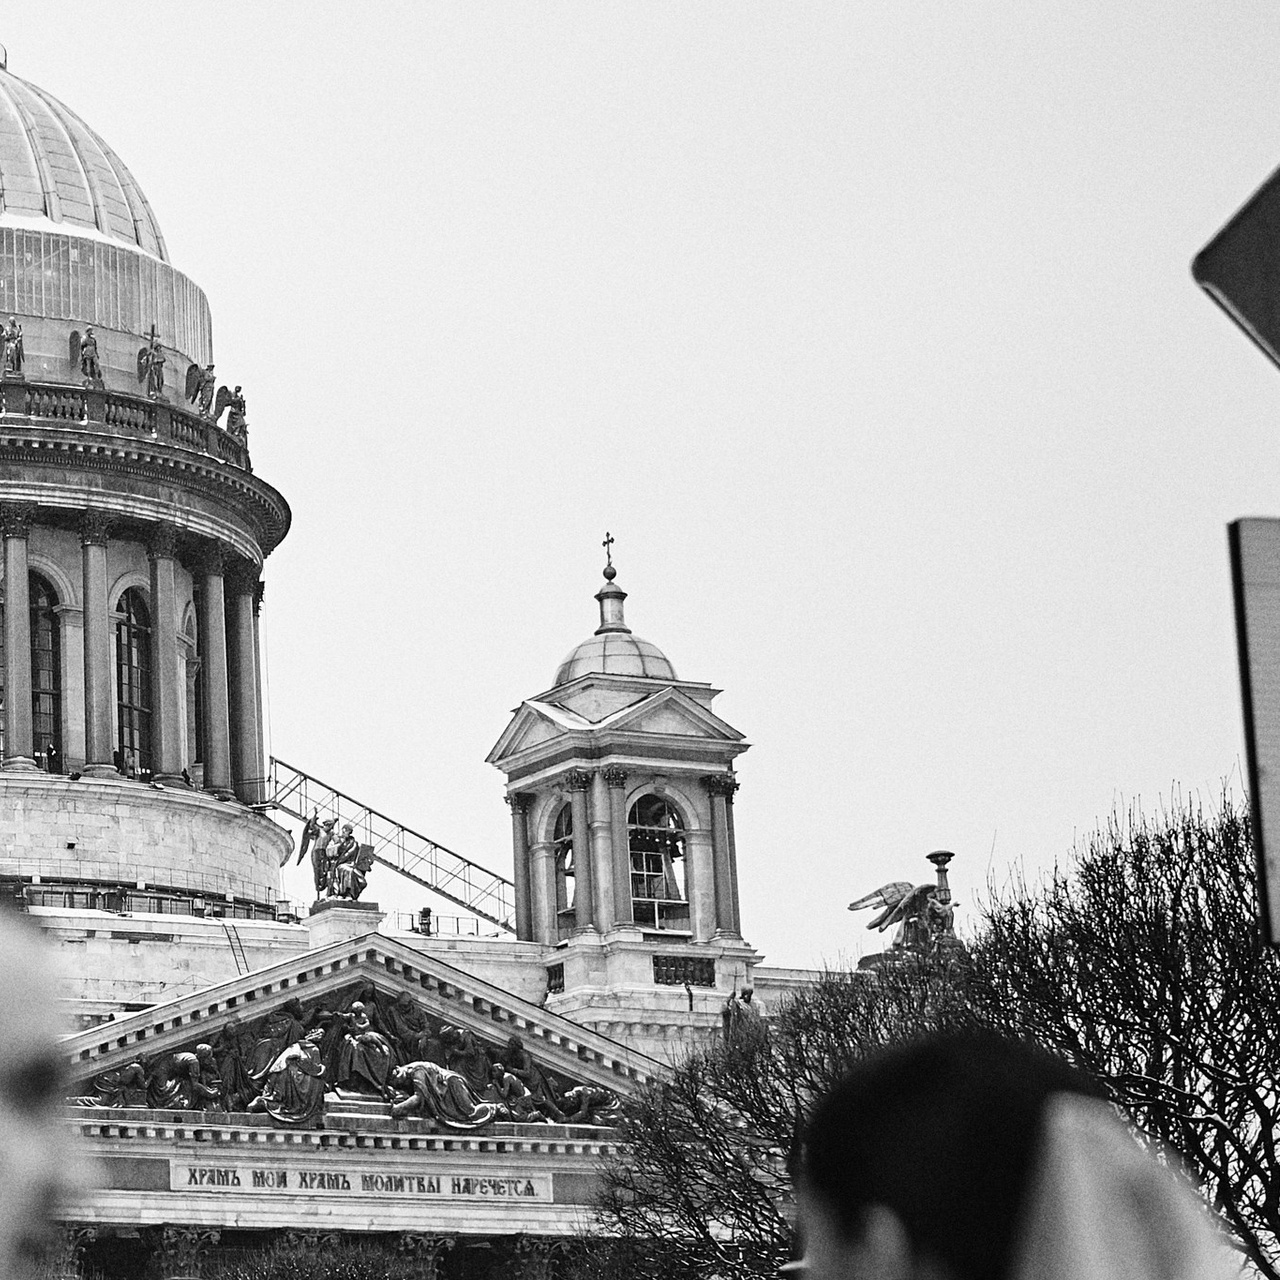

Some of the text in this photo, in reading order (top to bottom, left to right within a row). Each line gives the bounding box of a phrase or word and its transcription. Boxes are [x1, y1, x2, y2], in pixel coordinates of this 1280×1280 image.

[187, 1168, 241, 1187] ХРАМЪ
[298, 1171, 351, 1191] ХРАМЪ
[361, 1174, 441, 1194] МОЛИТВЫ
